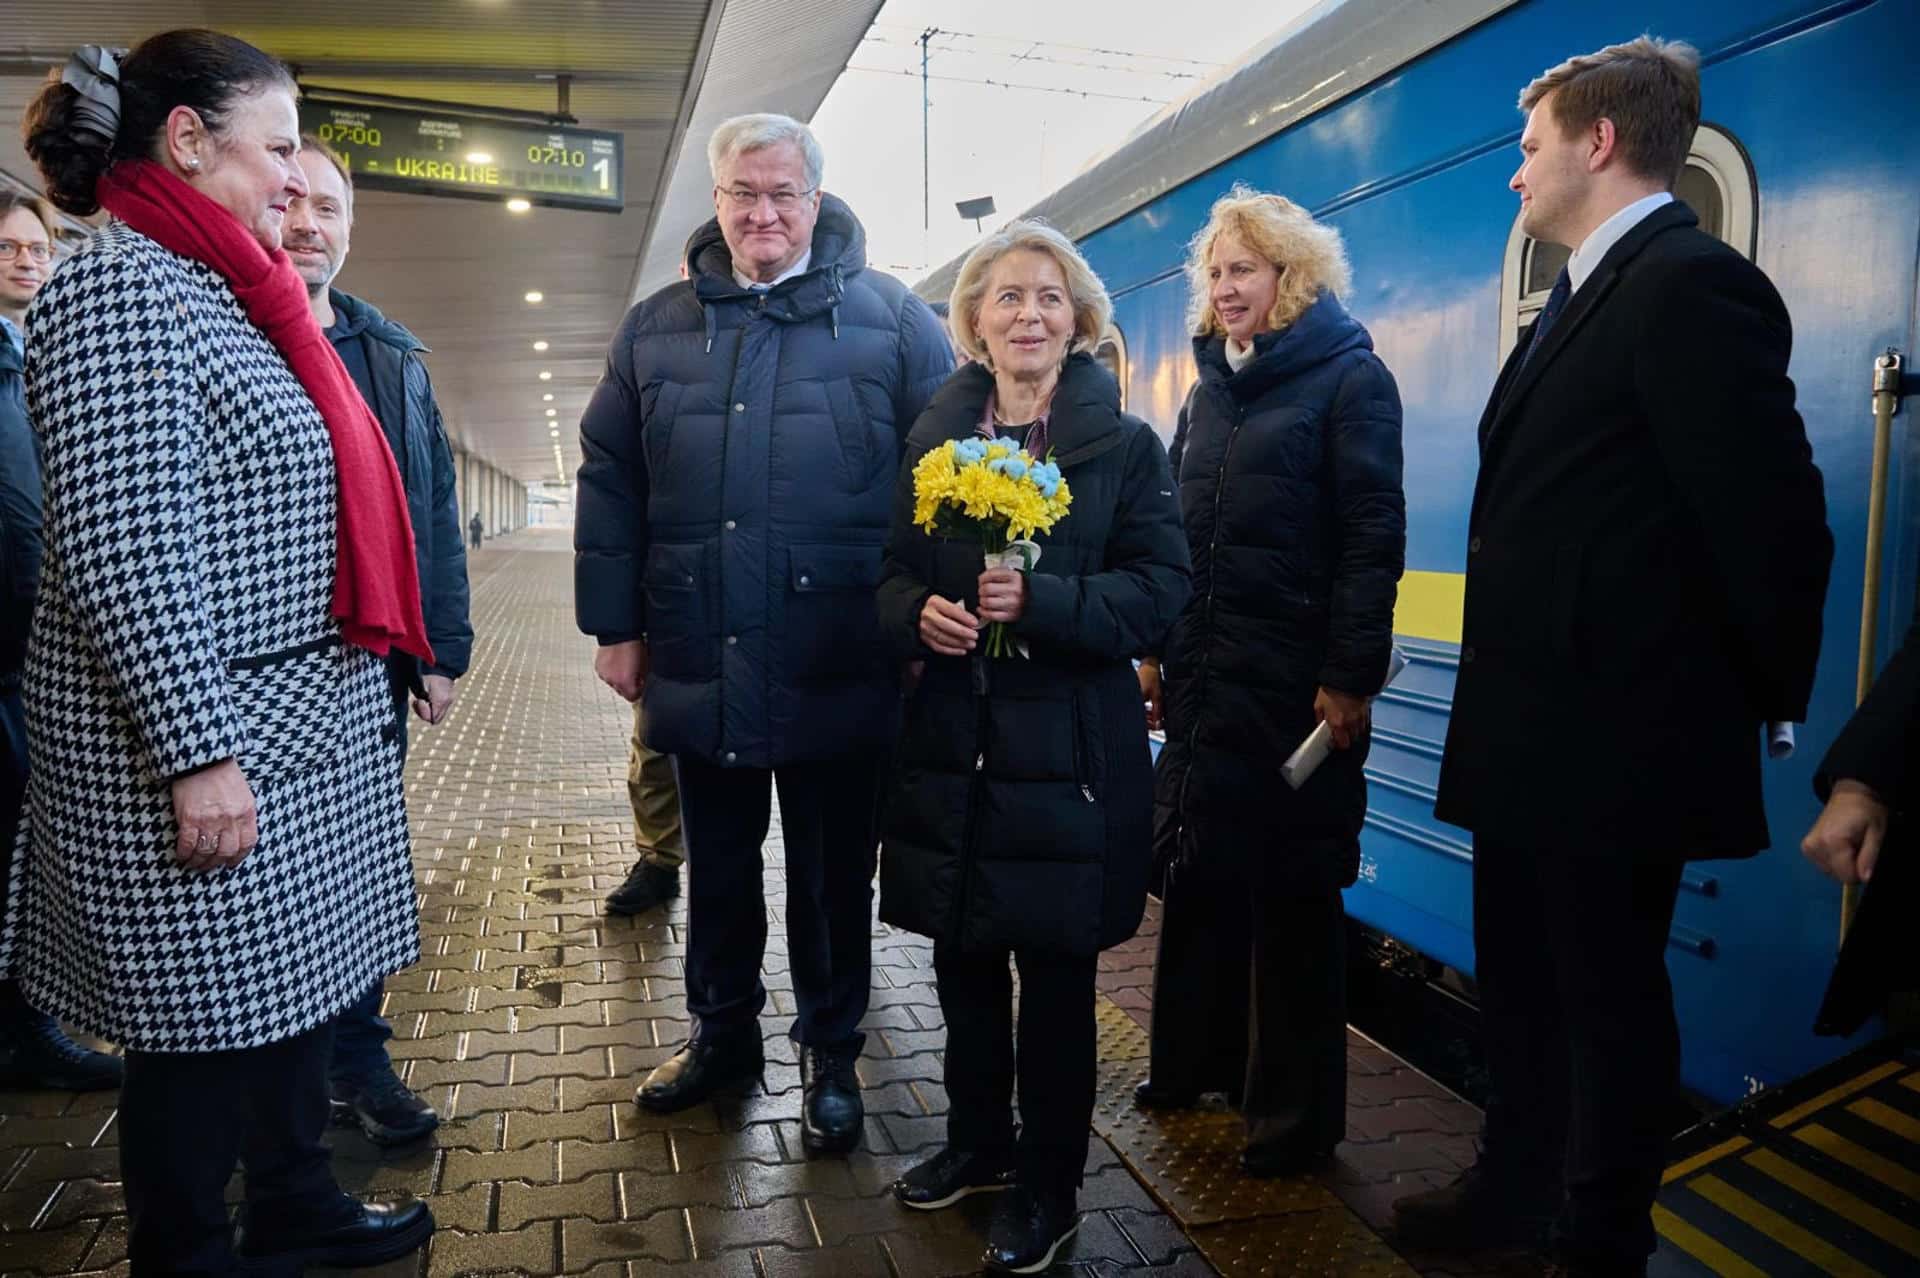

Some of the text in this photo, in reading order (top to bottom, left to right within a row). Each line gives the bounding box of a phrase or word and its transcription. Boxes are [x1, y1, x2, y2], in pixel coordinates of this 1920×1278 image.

[319, 124, 381, 147] 07:00
[528, 146, 585, 168] 07:10
[396, 157, 499, 184] UKRAINE
[592, 157, 609, 190] 1
